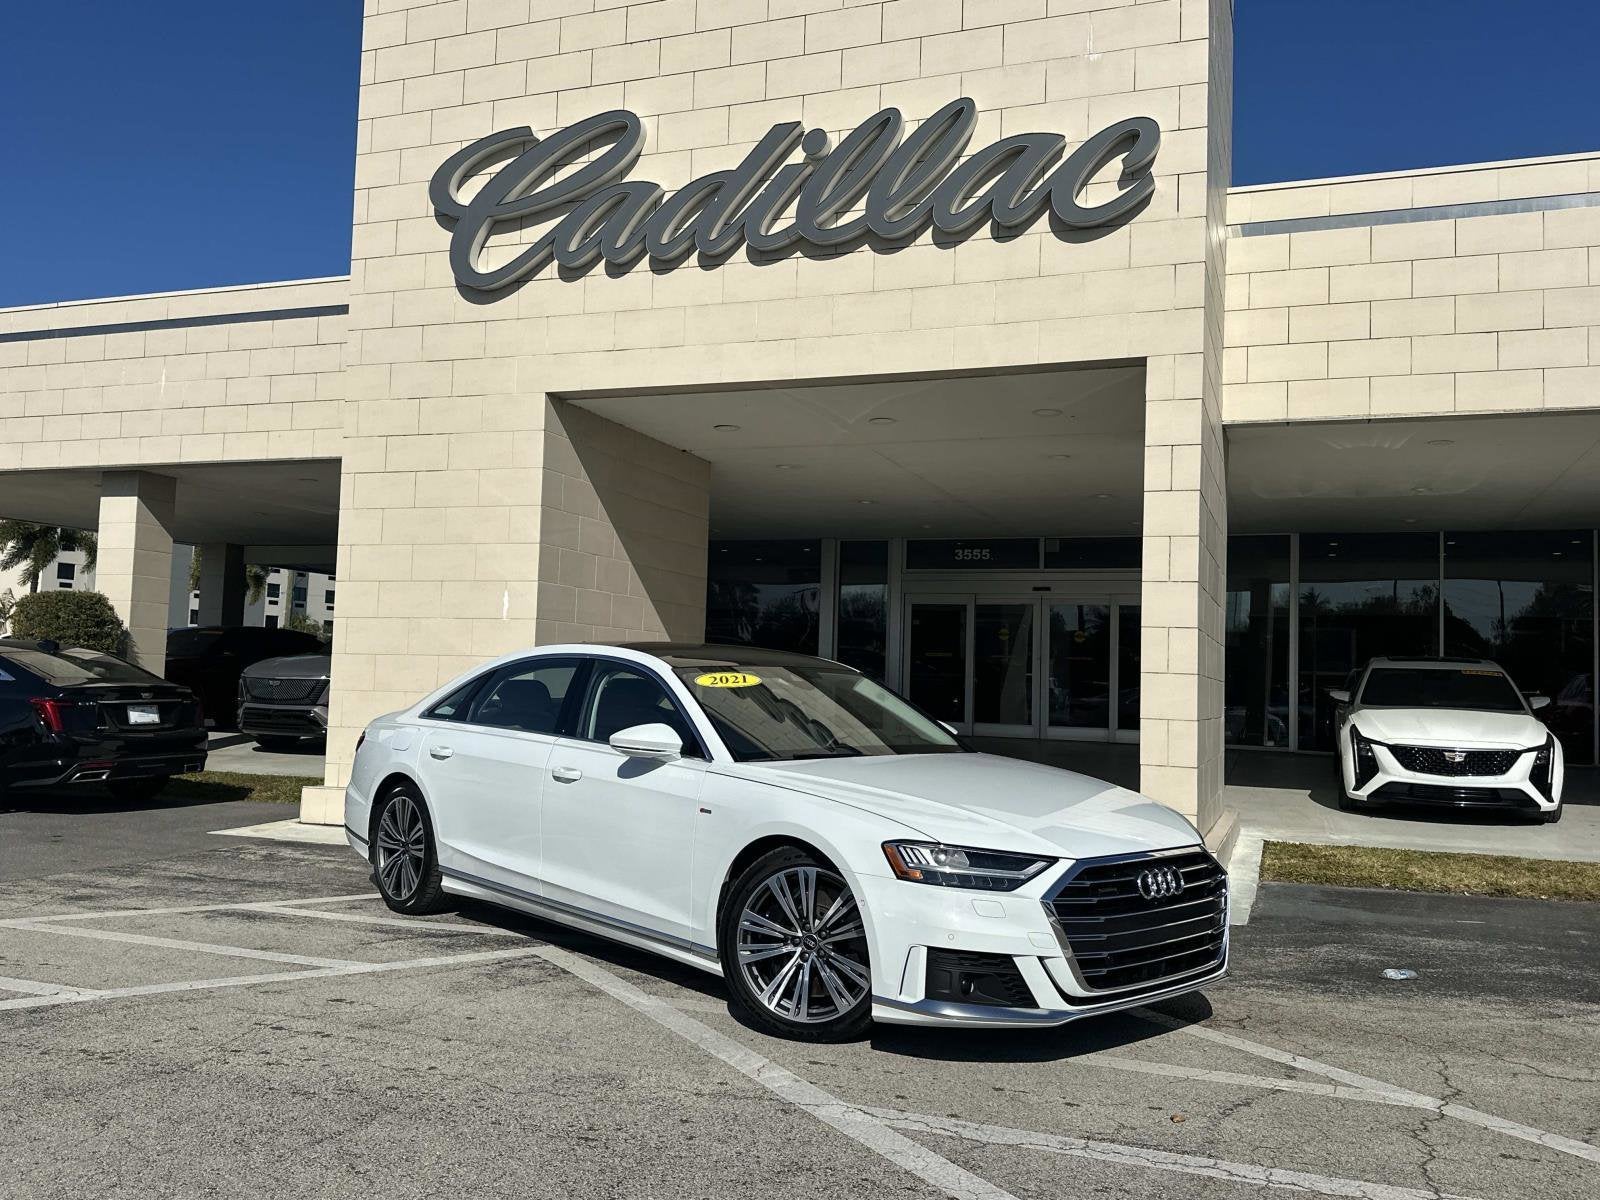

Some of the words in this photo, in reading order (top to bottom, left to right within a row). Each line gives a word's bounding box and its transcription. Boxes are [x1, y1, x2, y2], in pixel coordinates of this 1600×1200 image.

[428, 97, 1161, 291] Cadillac
[954, 549, 991, 560] 3555
[708, 675, 748, 685] 2021
